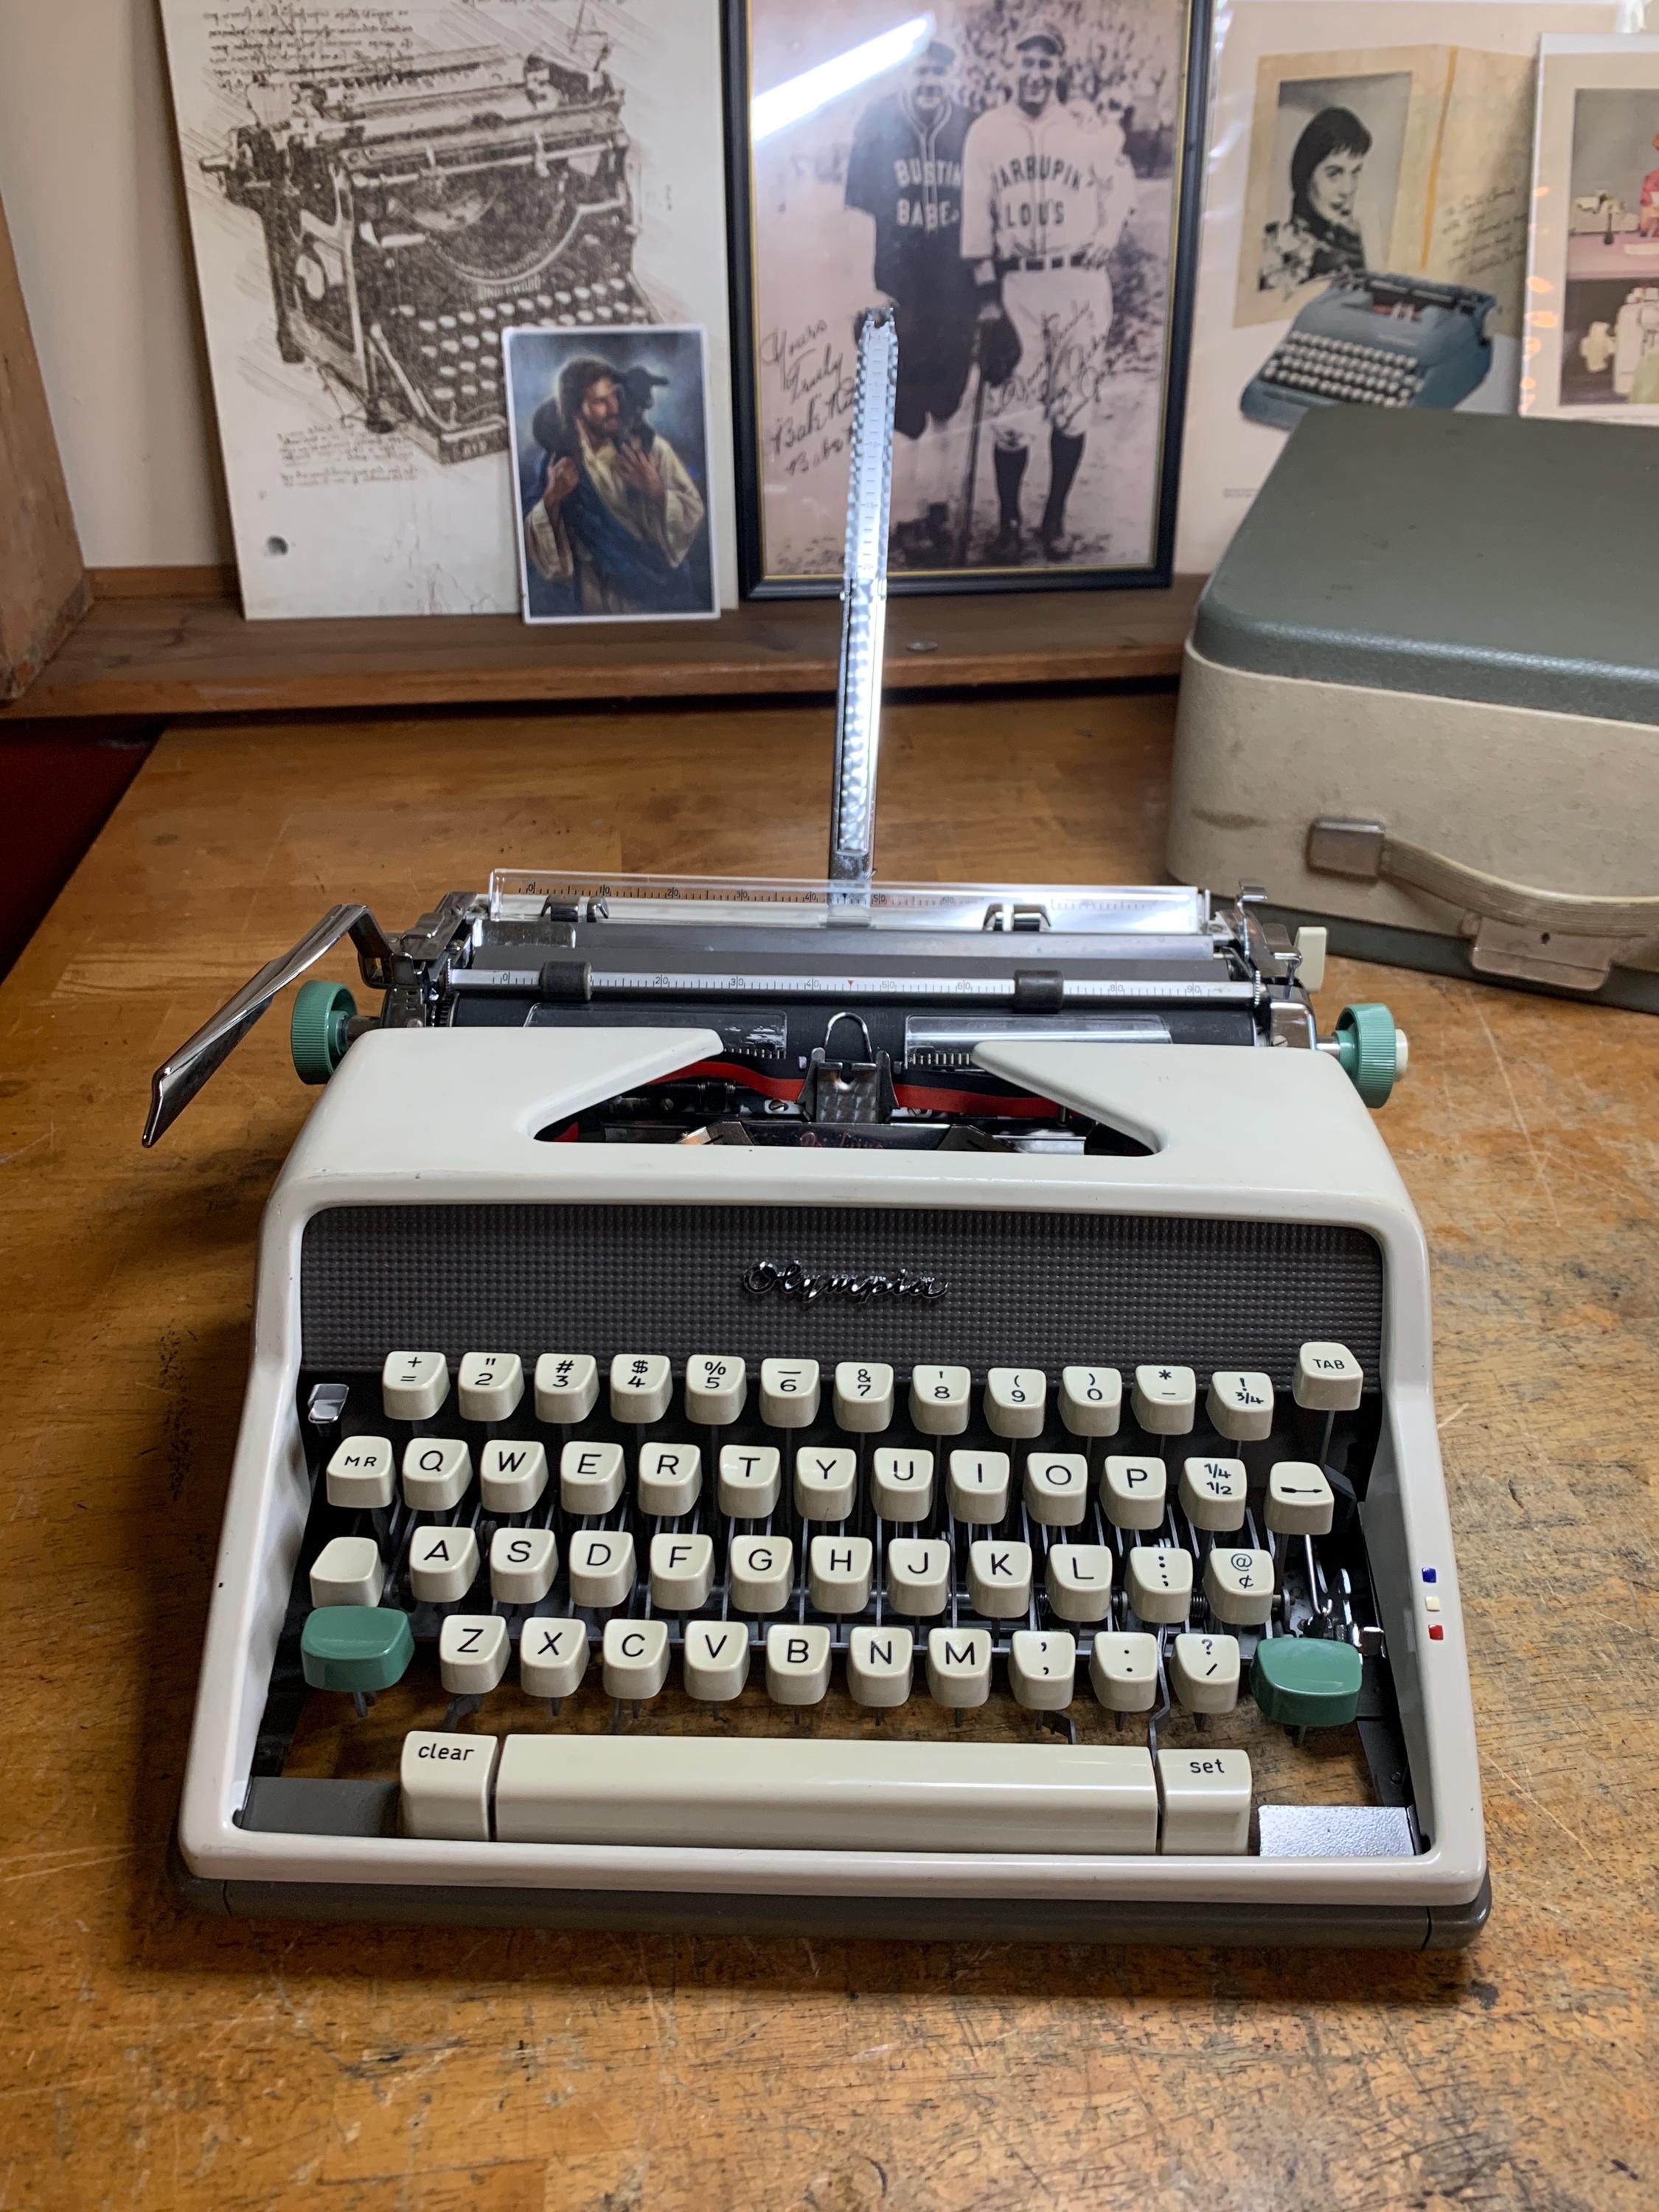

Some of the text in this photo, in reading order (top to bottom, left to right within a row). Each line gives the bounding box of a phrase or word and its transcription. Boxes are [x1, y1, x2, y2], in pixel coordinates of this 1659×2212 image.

[655, 975, 669, 985] 20
[731, 977, 743, 987] 30
[806, 978, 819, 988] 40
[743, 1258, 949, 1304] Olympia
[556, 1360, 574, 1374] #
[631, 1360, 649, 1374] $
[704, 1361, 726, 1375] %
[1312, 1358, 1345, 1369] TAB
[474, 1373, 493, 1386] 2
[552, 1375, 568, 1388] 3
[627, 1375, 646, 1388] 4
[705, 1377, 720, 1389] 5
[780, 1379, 797, 1392] 6
[858, 1368, 872, 1382] &
[1239, 1377, 1248, 1391] !
[858, 1384, 872, 1397] 7
[934, 1385, 950, 1399] 8
[1011, 1390, 1026, 1402] 9
[419, 1450, 444, 1472] Q
[498, 1451, 526, 1472] W
[577, 1453, 602, 1475] E
[656, 1454, 679, 1475] R
[739, 1457, 761, 1478] T
[815, 1459, 837, 1480] Y
[893, 1460, 914, 1481] U
[1126, 1468, 1148, 1489] P
[423, 1540, 450, 1562] A
[507, 1540, 532, 1563] S
[586, 1543, 611, 1566] D
[669, 1546, 692, 1568] F
[748, 1548, 773, 1571] G
[830, 1549, 852, 1572] H
[908, 1552, 928, 1574] J
[990, 1553, 1013, 1576] K
[1072, 1557, 1094, 1580] L
[1231, 1553, 1253, 1572] @
[456, 1628, 484, 1653] Z
[538, 1631, 563, 1656] X
[622, 1633, 645, 1658] C
[705, 1634, 728, 1659] V
[787, 1638, 809, 1663] B
[1201, 1639, 1213, 1655] ?
[870, 1641, 892, 1665] N
[945, 1641, 975, 1666] M
[418, 1743, 475, 1761] clear
[1189, 1759, 1225, 1773] set
